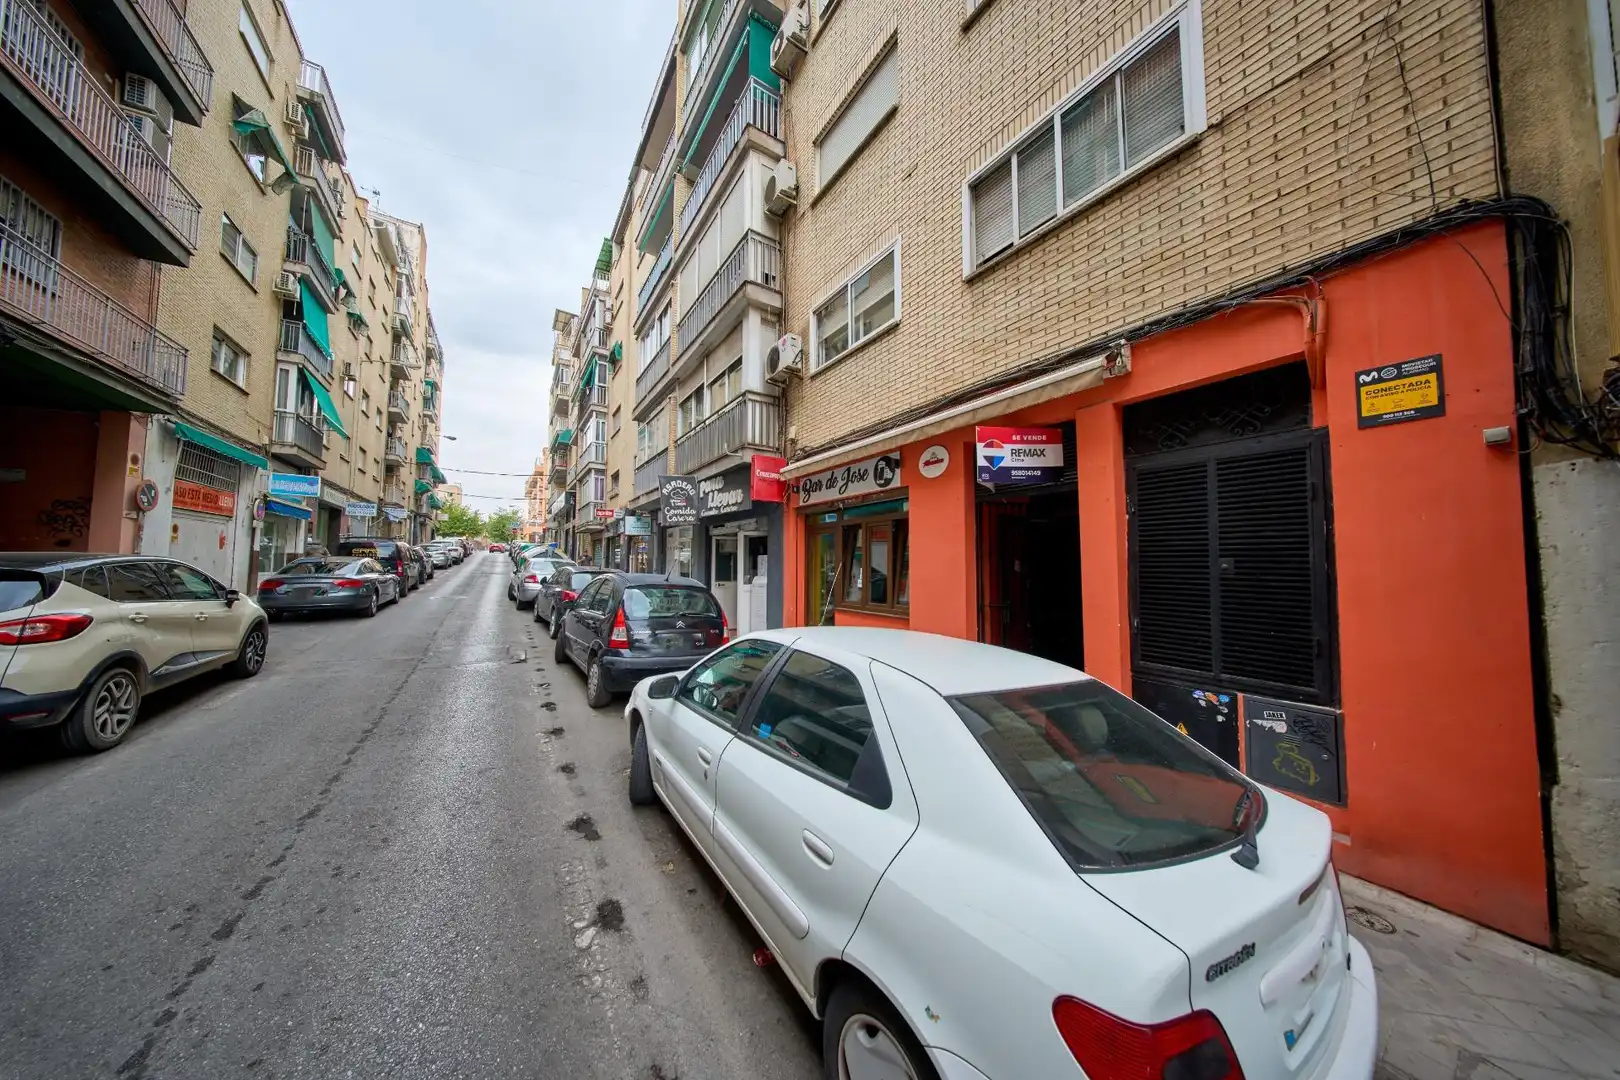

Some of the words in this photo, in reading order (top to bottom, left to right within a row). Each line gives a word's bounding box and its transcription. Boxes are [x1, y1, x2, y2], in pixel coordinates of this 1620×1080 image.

[1365, 379, 1432, 396] CONECTADA
[1010, 448, 1046, 458] REMAX
[756, 469, 782, 480] Cruzcamp
[662, 480, 696, 496] ASADERO
[802, 478, 823, 503] Bar
[825, 471, 838, 489] de
[838, 466, 869, 495] Jose
[664, 506, 697, 515] Comida
[666, 513, 696, 522] Casera
